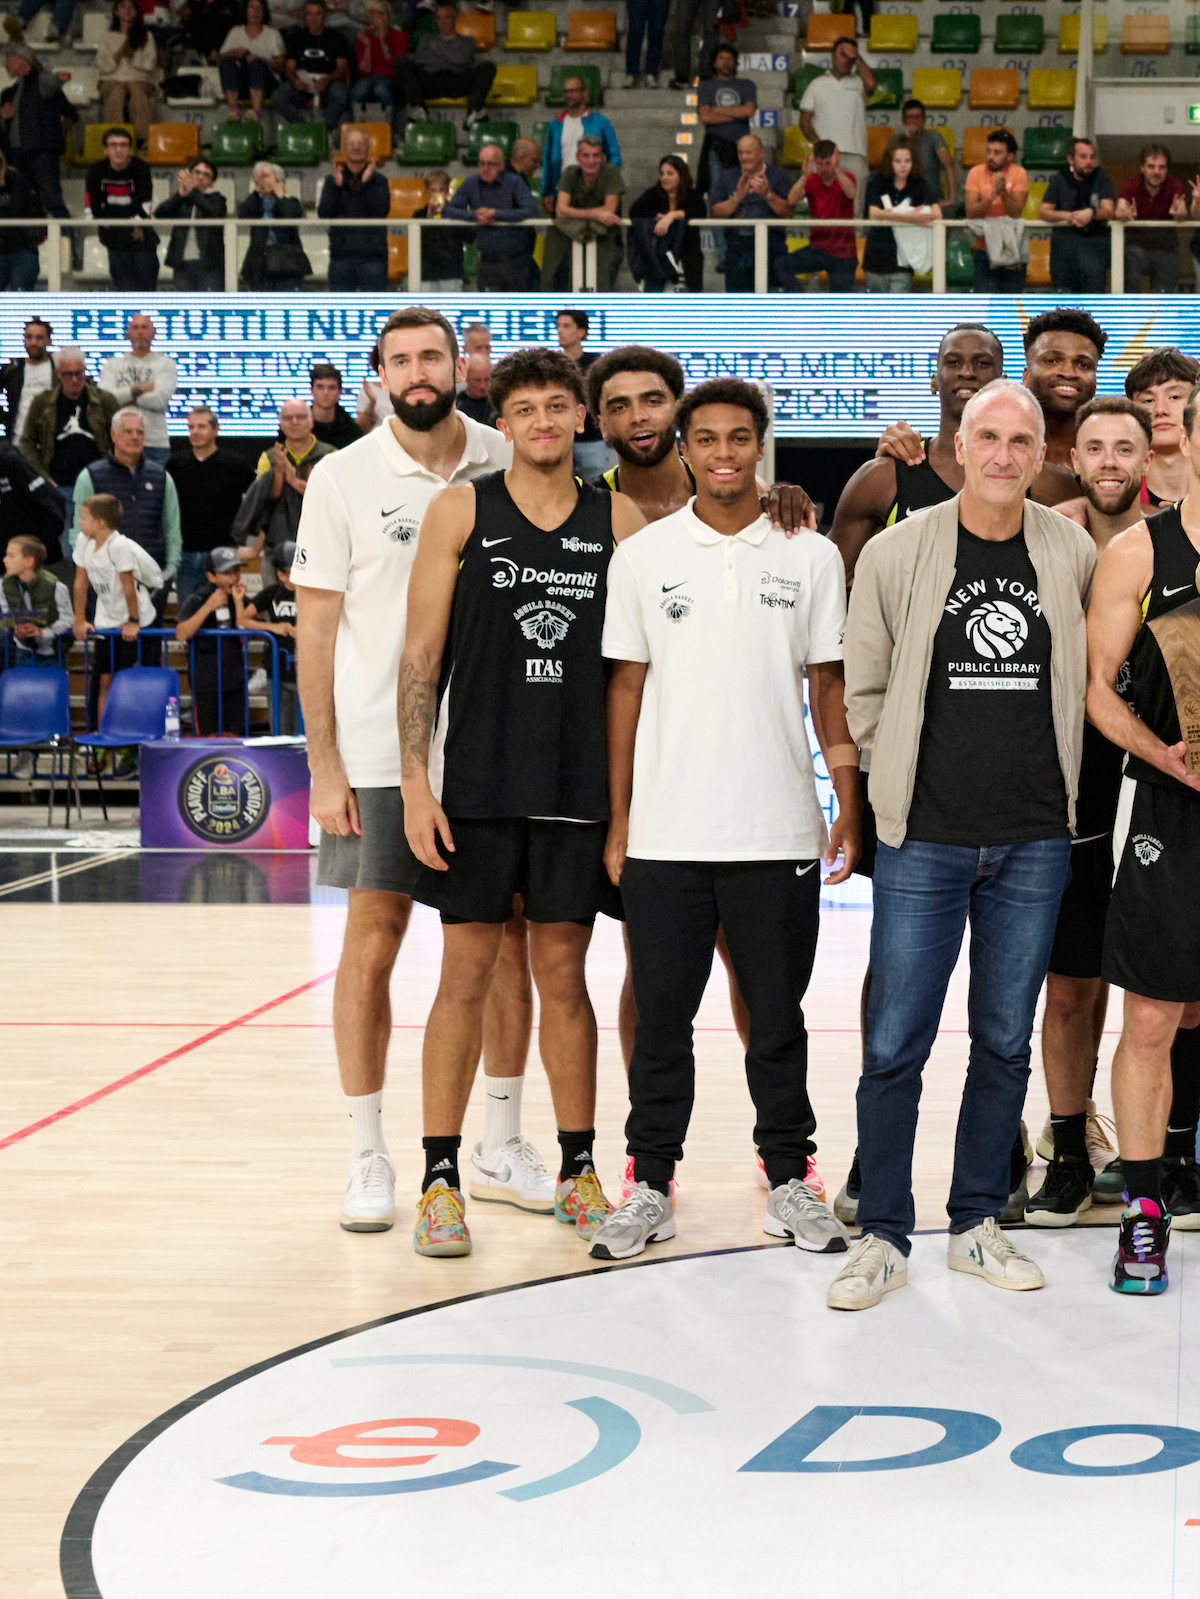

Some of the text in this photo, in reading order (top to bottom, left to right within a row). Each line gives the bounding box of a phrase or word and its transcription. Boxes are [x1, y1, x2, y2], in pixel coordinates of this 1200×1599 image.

[775, 56, 787, 70] 6
[158, 309, 267, 340] TUTTI
[560, 537, 603, 554] TRENTINO
[521, 567, 598, 588] Dolomiti
[546, 586, 594, 600] energia
[944, 579, 987, 616] NEW
[272, 601, 298, 618] VAN
[513, 600, 544, 621] AQUILA
[526, 659, 563, 677] ITAS
[948, 662, 1041, 673] PUBLIC LIBRARY
[187, 770, 209, 822] PLAYOFF
[213, 786, 236, 796] LBA
[240, 771, 262, 824] PLAYOFF
[207, 820, 240, 834] 2024
